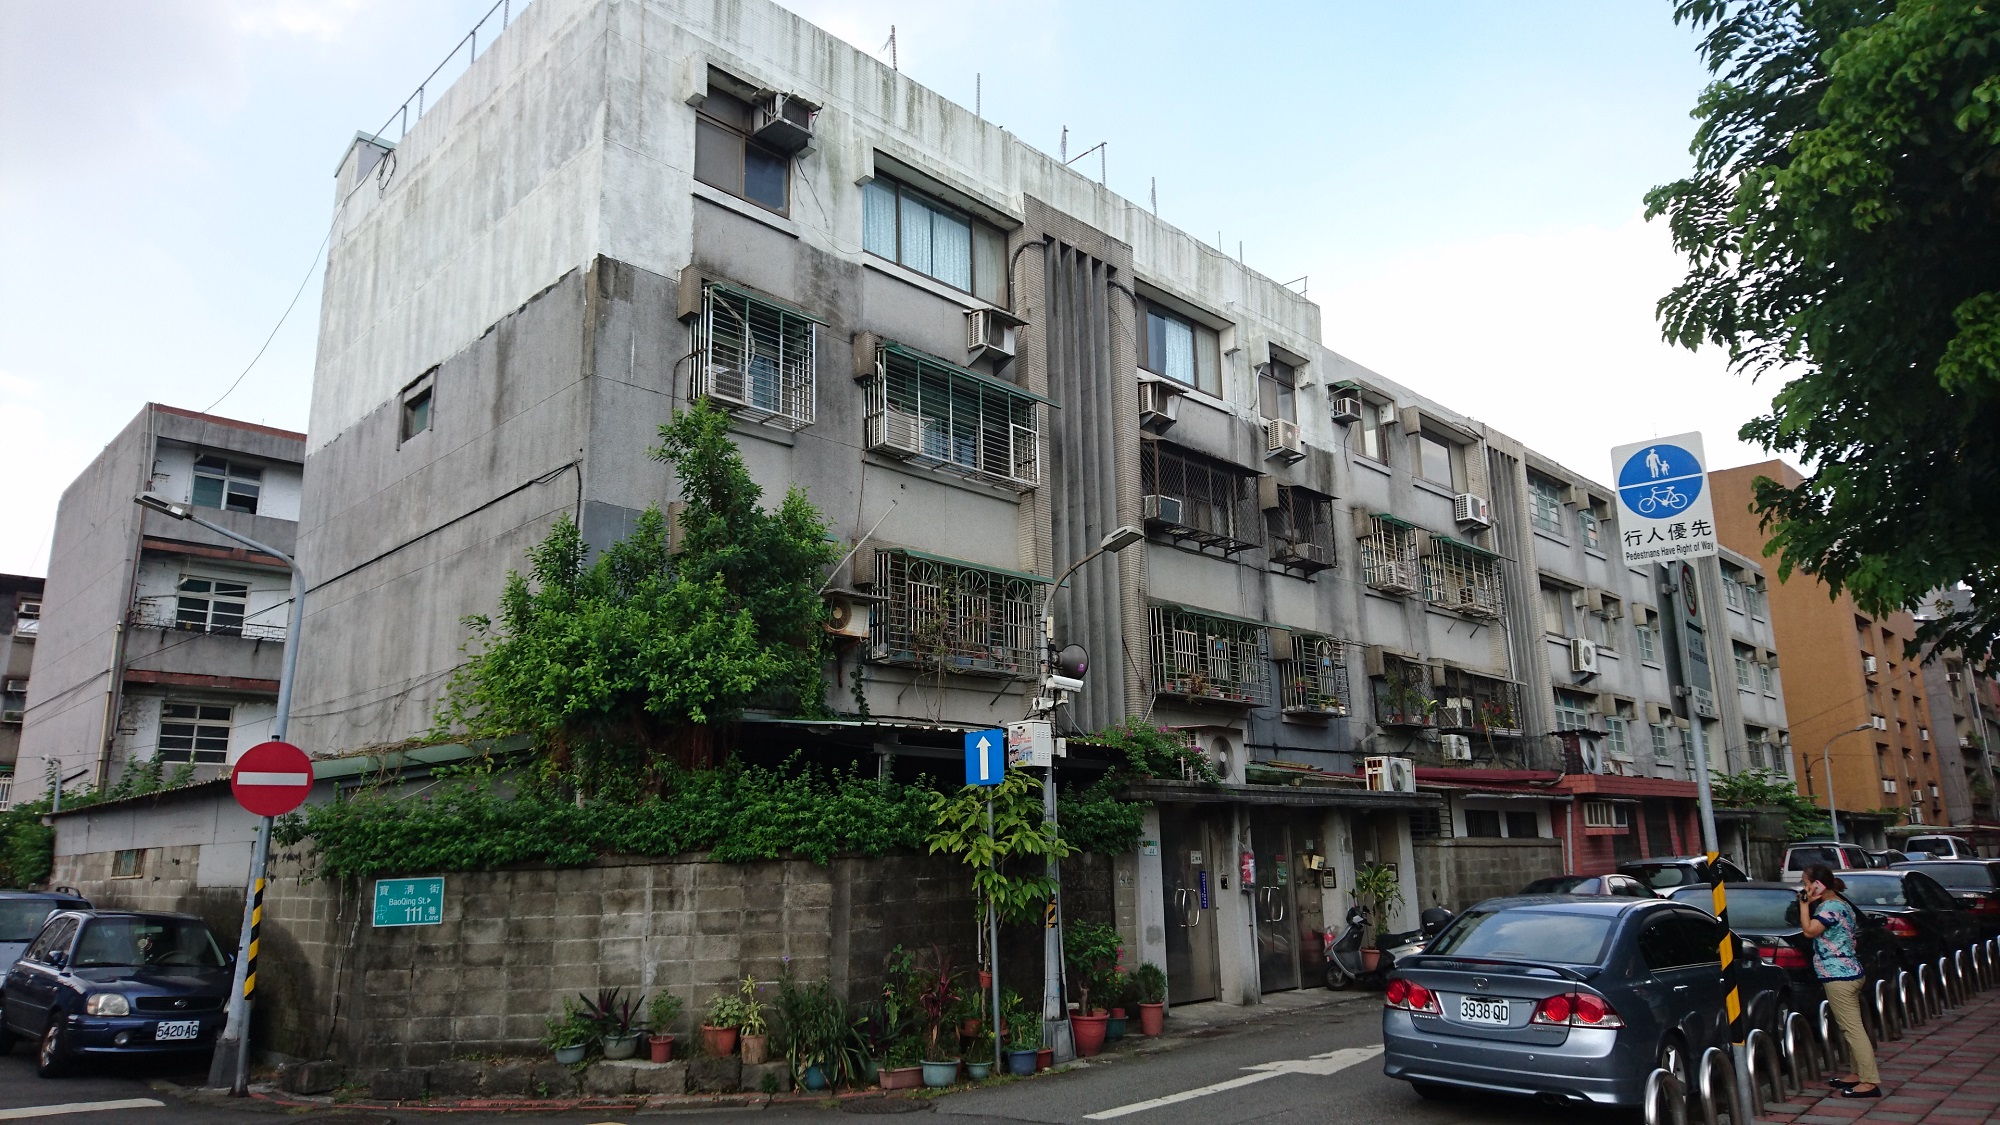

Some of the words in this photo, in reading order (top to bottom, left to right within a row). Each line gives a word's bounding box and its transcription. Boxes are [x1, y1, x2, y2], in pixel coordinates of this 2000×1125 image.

[1624, 519, 1712, 547] 行人優先
[1626, 548, 1660, 561] Pedestrians
[1661, 546, 1676, 557] Have
[1677, 543, 1693, 556] Right
[1693, 541, 1700, 552] of
[1701, 540, 1714, 552] Way
[379, 883, 440, 896] 寶清街
[388, 898, 416, 906] BaoQing
[404, 906, 423, 922] 111
